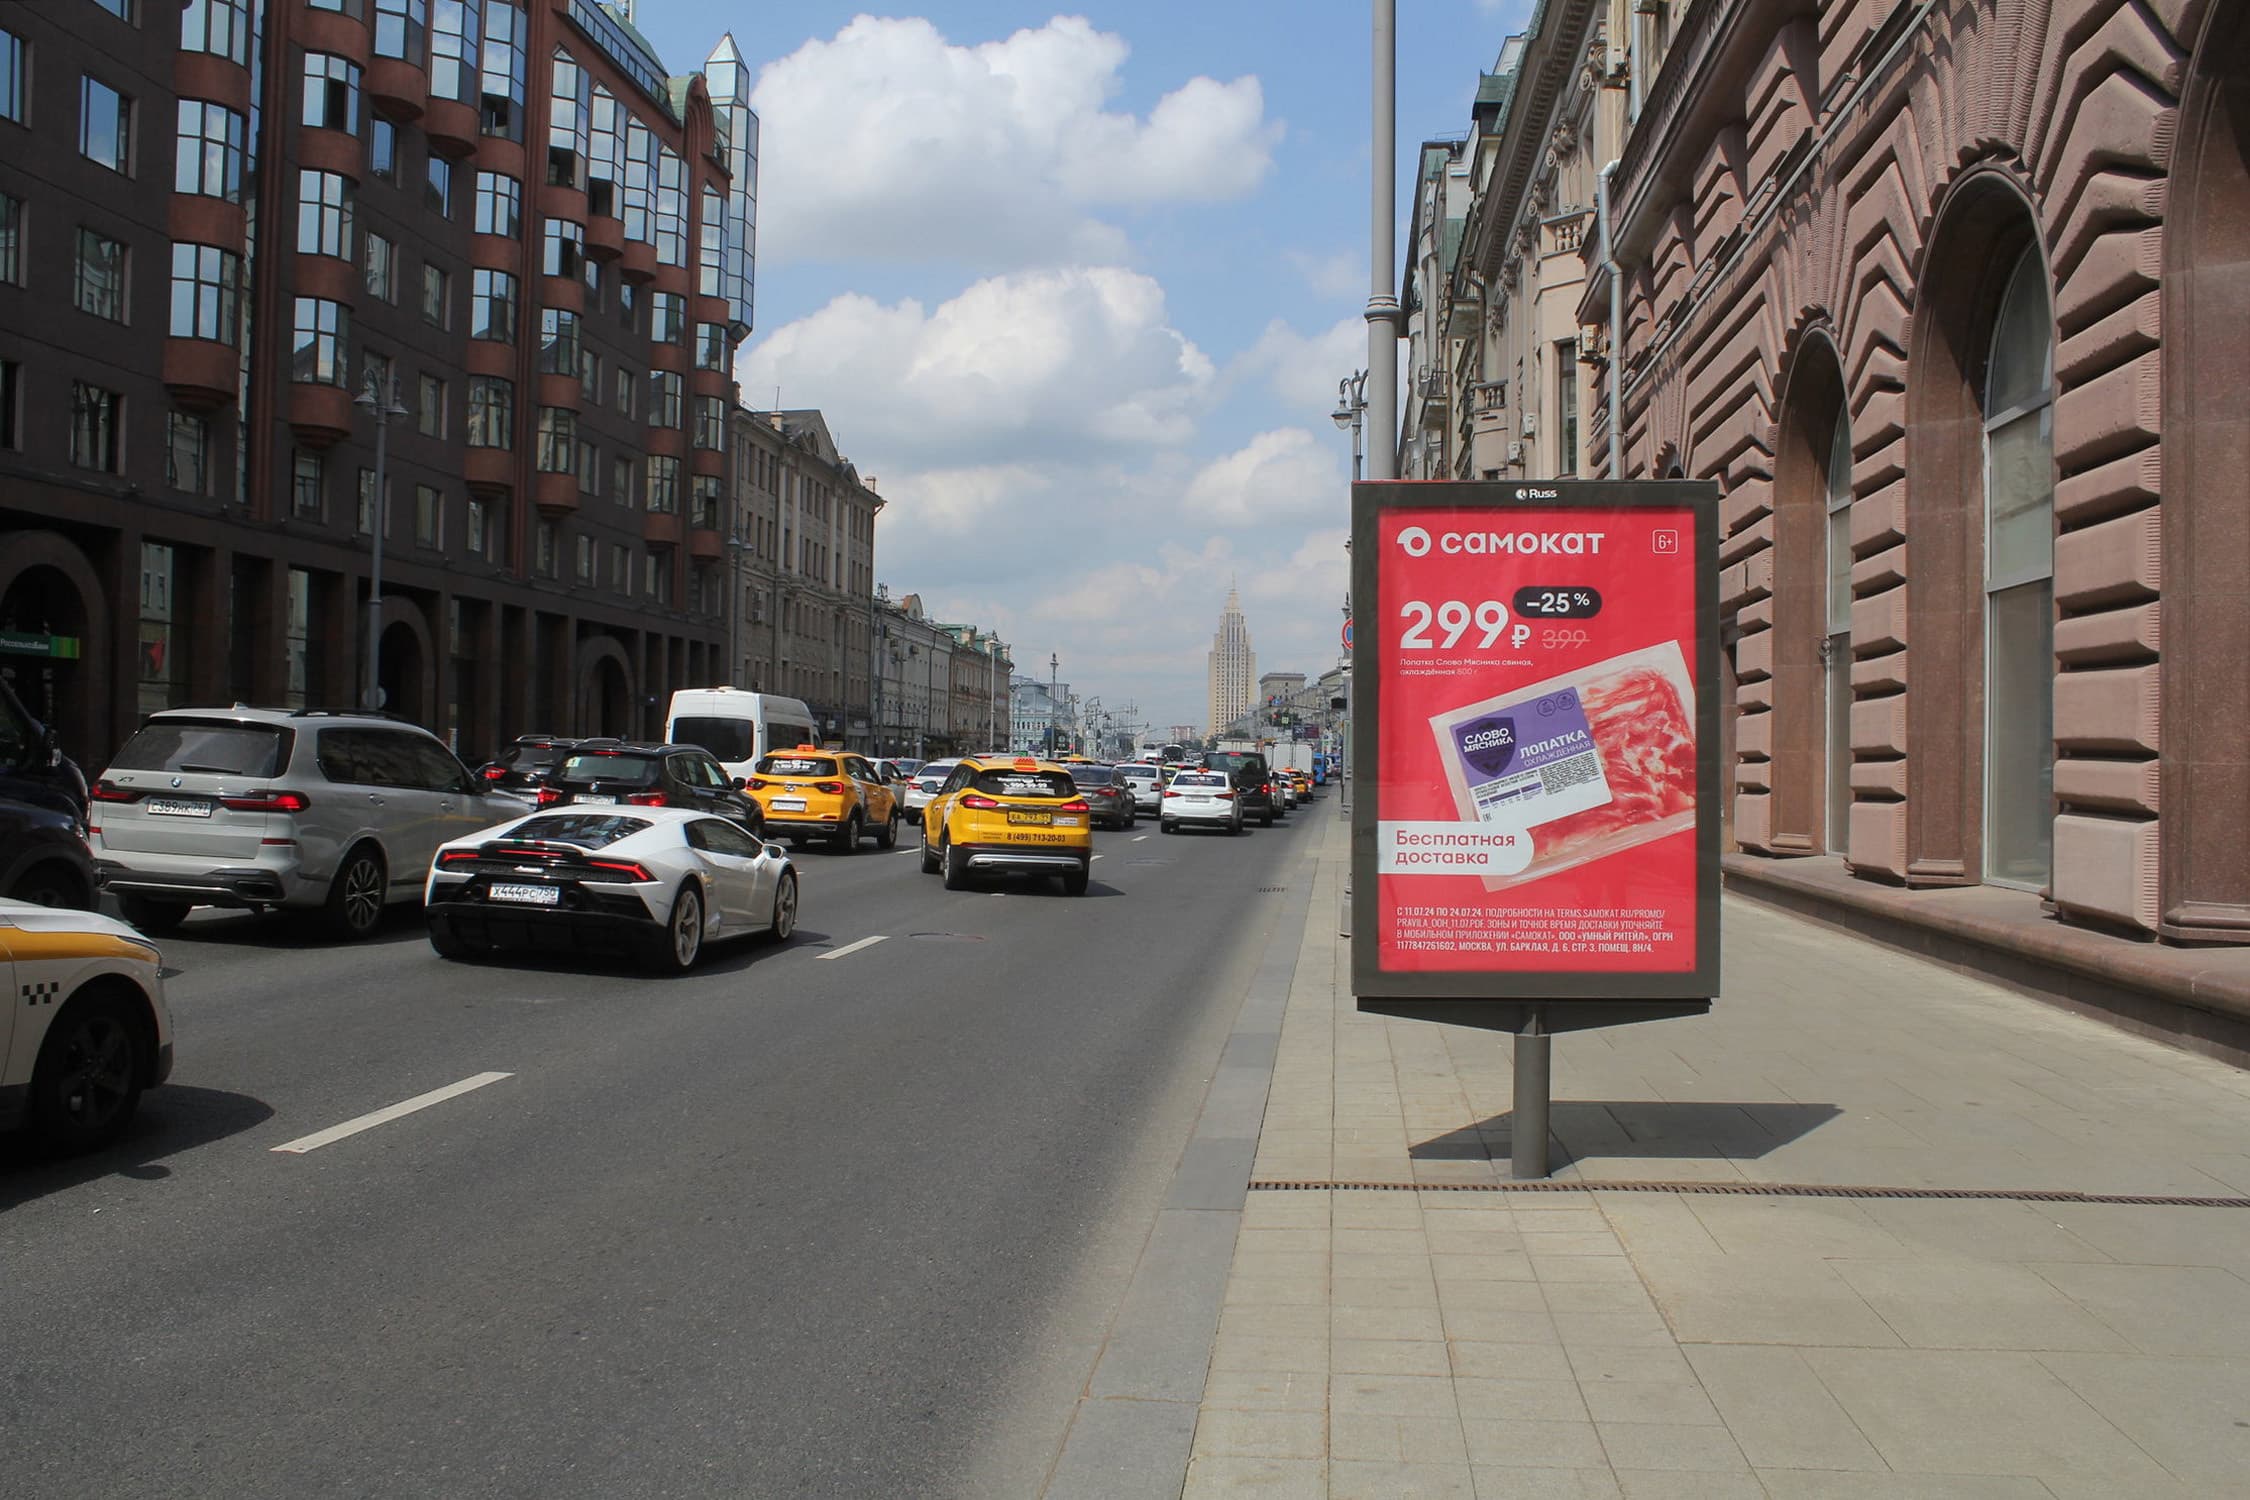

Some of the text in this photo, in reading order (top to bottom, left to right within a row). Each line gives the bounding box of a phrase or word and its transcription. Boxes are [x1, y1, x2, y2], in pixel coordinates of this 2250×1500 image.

[1529, 488, 1557, 499] Russ
[1440, 532, 1605, 555] самокат
[1658, 534, 1673, 549] 6+
[1542, 629, 1588, 650] 399
[1400, 658, 1534, 667] Лопатка Слово Мясника свиная,
[1400, 668, 1456, 676] охлаждённая
[1465, 727, 1510, 744] СЛОВО
[1463, 736, 1514, 753] МЯСНИКА
[1520, 729, 1588, 759] ЛОПАТКА
[1523, 740, 1592, 767] ОХЛАЖДЕННАЯ
[1396, 829, 1516, 847] Бесплатная
[1395, 849, 1489, 866] доставка
[1397, 907, 1402, 916] С
[1405, 907, 1434, 916] 11.07.24
[1436, 907, 1448, 916] ПО
[1485, 908, 1543, 918] ПОДРОБНОСТИ
[1545, 909, 1555, 918] НА
[1488, 920, 1510, 929] ЗОНЫ
[1511, 920, 1517, 929] И
[1519, 920, 1549, 929] ТОЧНОЕ
[1550, 920, 1577, 929] ВРЕМЯ
[1578, 920, 1619, 930] ДОСТАВКИ
[1620, 919, 1664, 930] УТОЧНЯЙТЕ
[1396, 930, 1402, 938] В
[1404, 930, 1454, 939] МОБИЛЬНОМ
[1455, 930, 1509, 940] ПРИЛОЖЕНИИ
[1559, 932, 1576, 941] ООО
[1577, 930, 1611, 941] «УМНЫЙ
[1652, 932, 1674, 942] ОГРН
[1459, 942, 1495, 952] МОСКВА,
[1496, 942, 1508, 952] УЛ.
[1510, 942, 1550, 953] БАРКЛАЯ,
[1551, 943, 1561, 953] Д.
[1571, 944, 1587, 953] СТР.
[1598, 944, 1630, 954] ПОМЕЩ.
